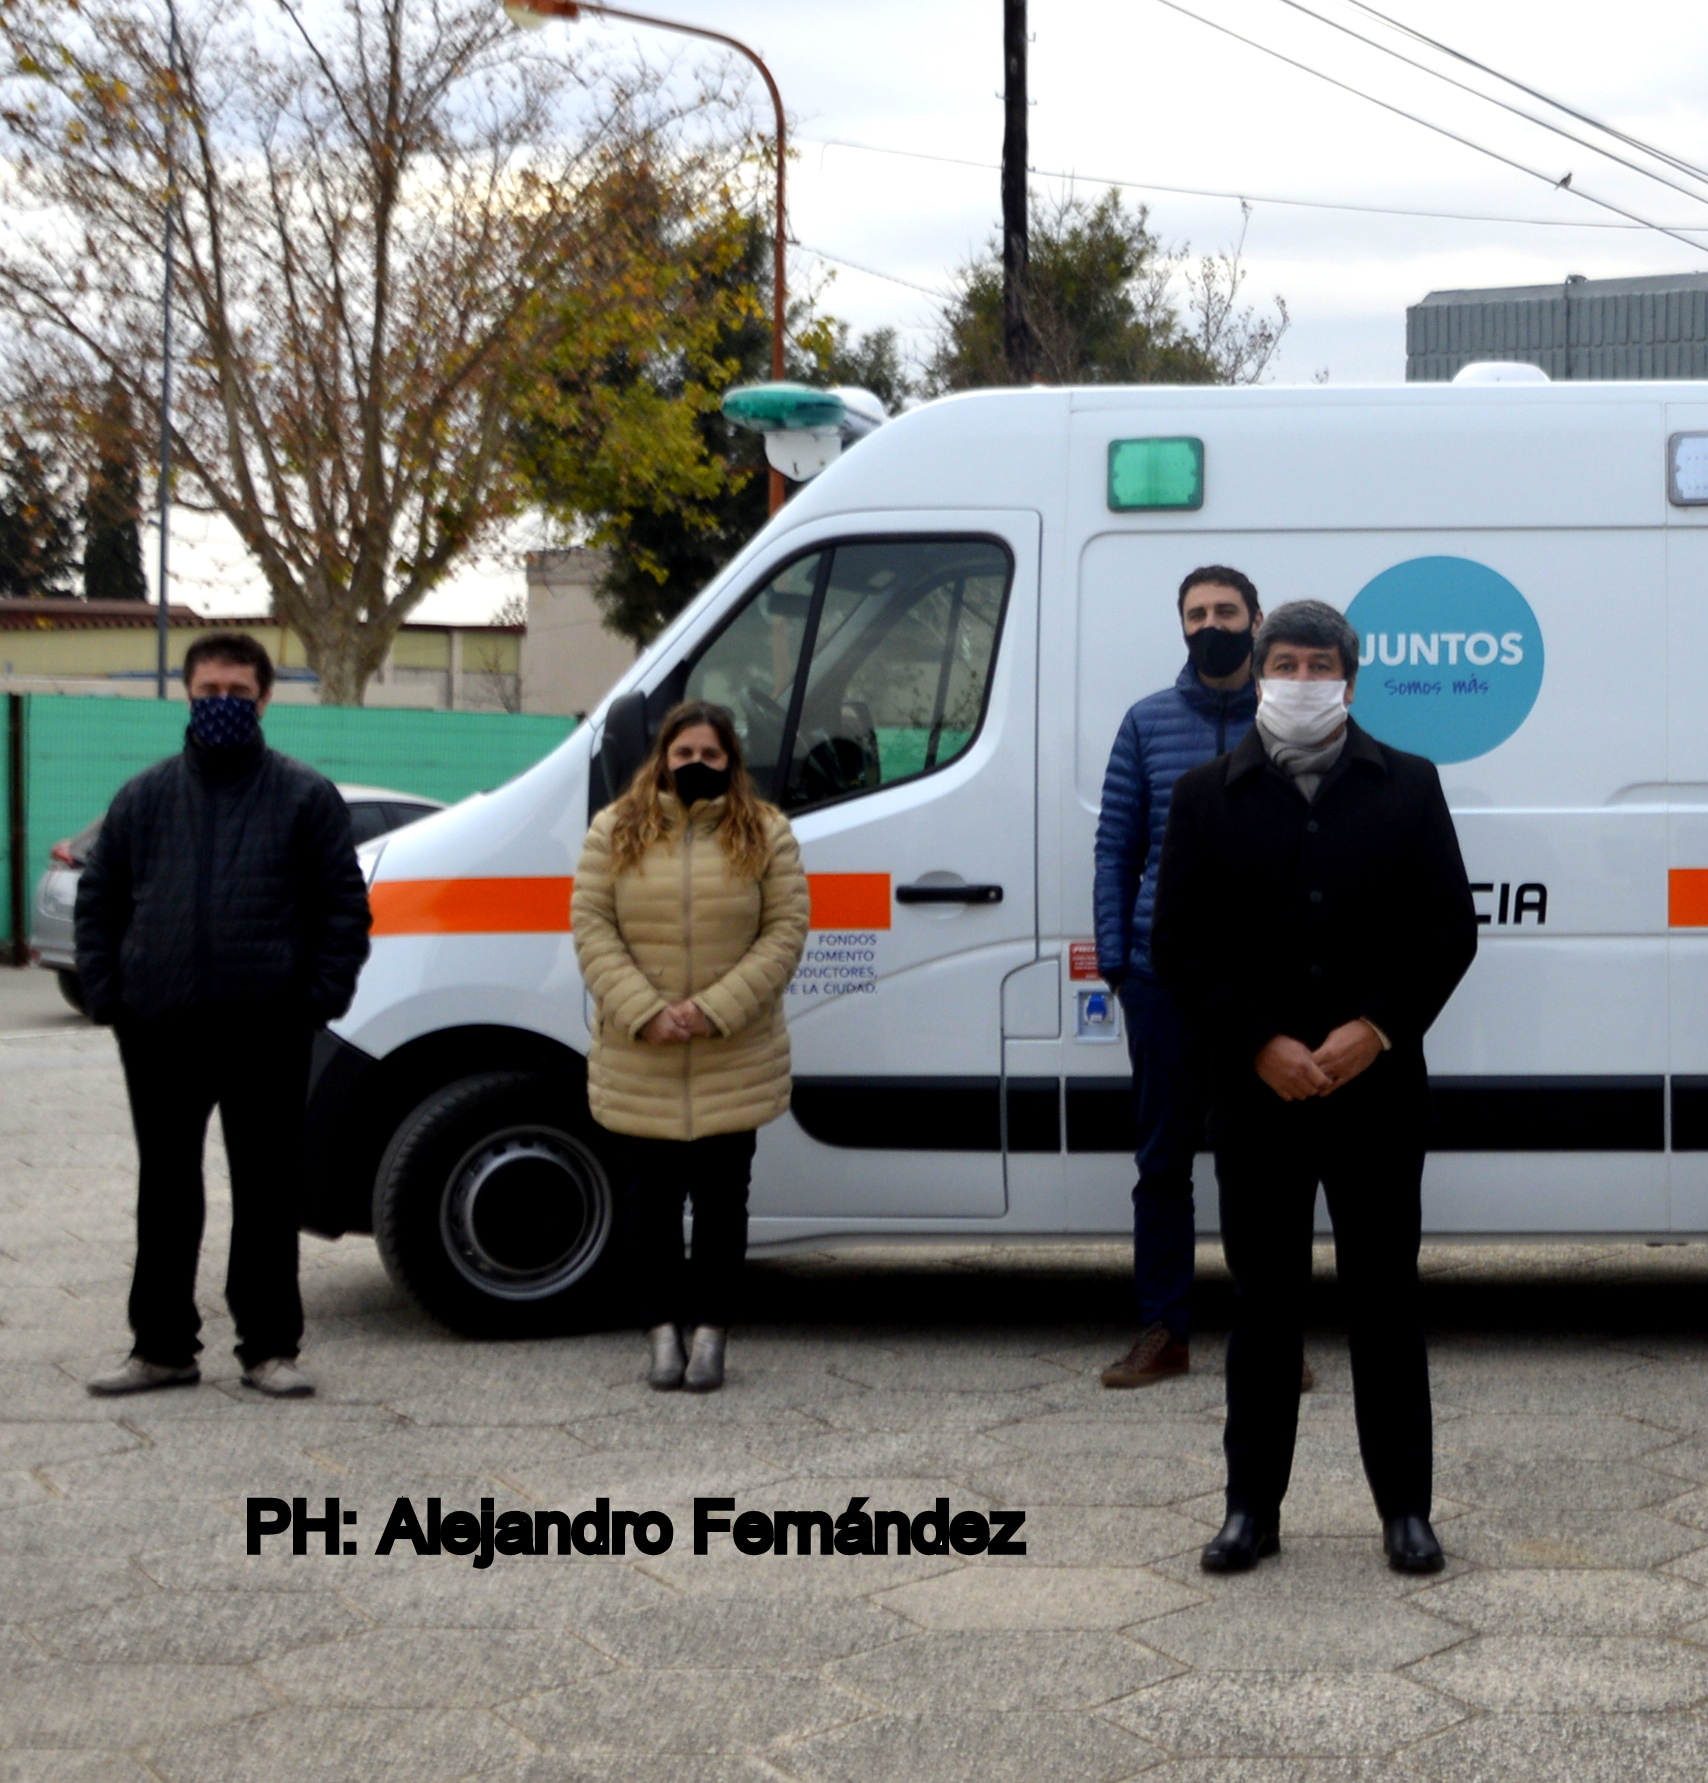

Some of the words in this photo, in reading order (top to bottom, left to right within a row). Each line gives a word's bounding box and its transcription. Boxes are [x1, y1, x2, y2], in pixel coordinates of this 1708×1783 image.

[1358, 632, 1523, 666] JUNTOS
[1384, 678, 1442, 696] Somos
[1452, 673, 1489, 695] más
[818, 934, 877, 946] FONDOS
[807, 950, 875, 962] FOMENTO
[802, 983, 819, 995] LA
[823, 982, 878, 995] CIUDAD.
